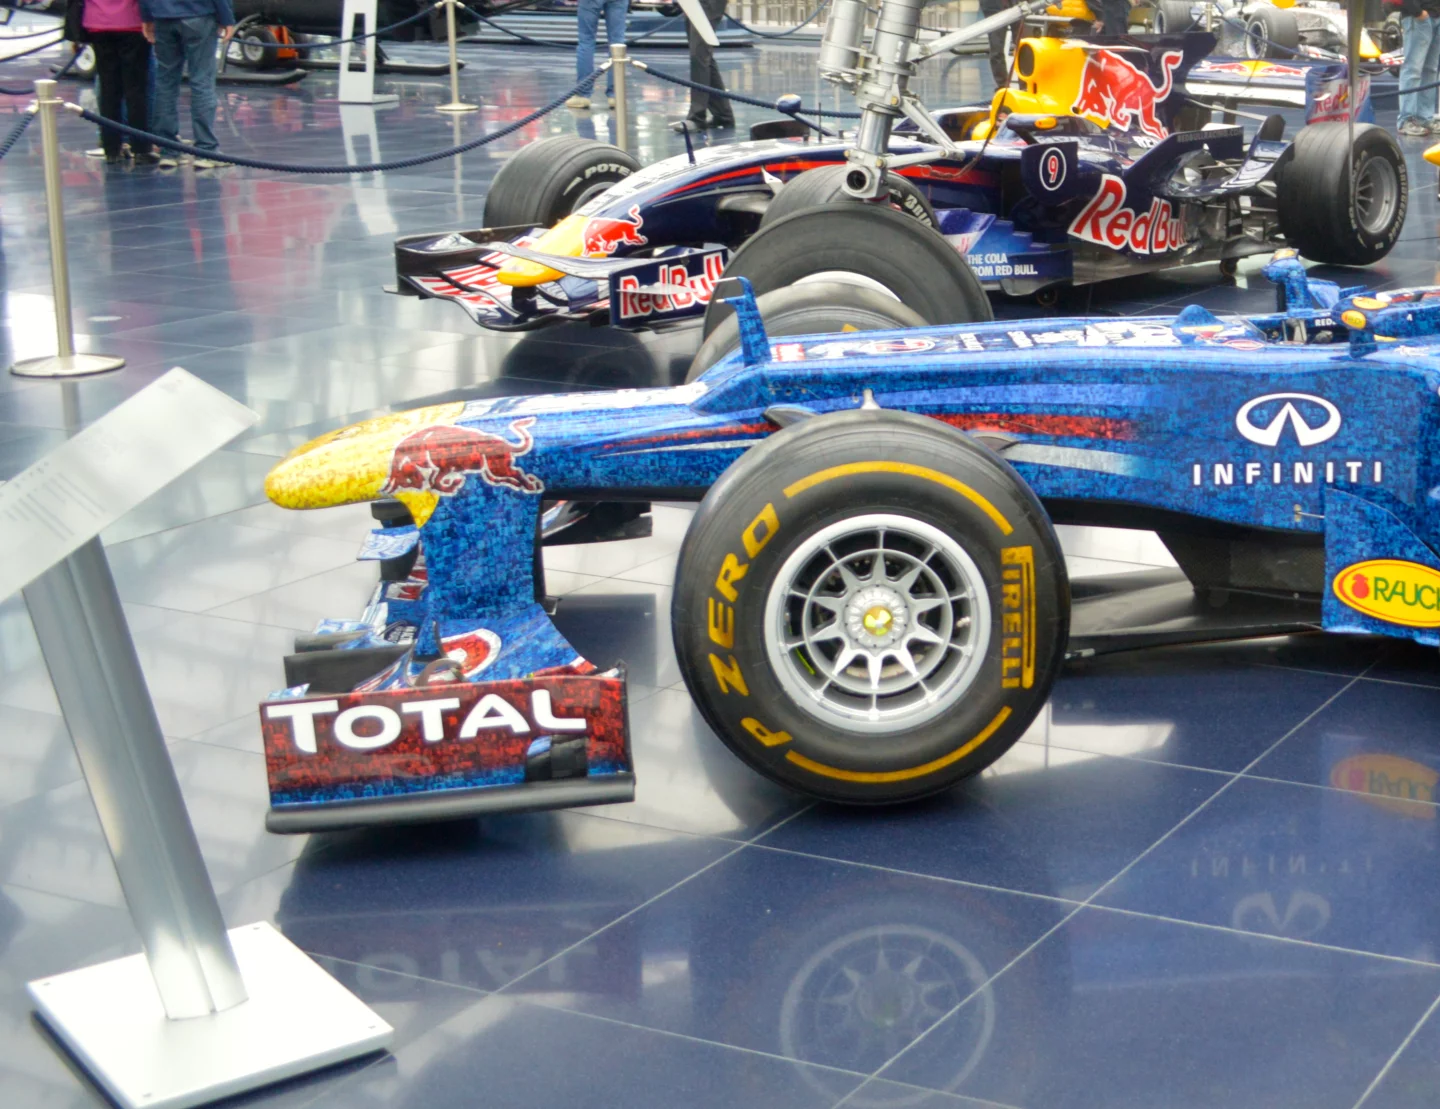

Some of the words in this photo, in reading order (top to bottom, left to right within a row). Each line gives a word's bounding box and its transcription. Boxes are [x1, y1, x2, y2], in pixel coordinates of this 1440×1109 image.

[585, 163, 634, 179] POTE
[1047, 155, 1059, 183] 9
[972, 265, 994, 276] ROM
[995, 265, 1012, 275] RED
[985, 253, 1008, 264] COLA
[1193, 462, 1383, 486] INFINITI
[708, 503, 781, 697] ZERO
[1001, 545, 1035, 689] PIRELLI
[265, 689, 588, 754] TOTAL
